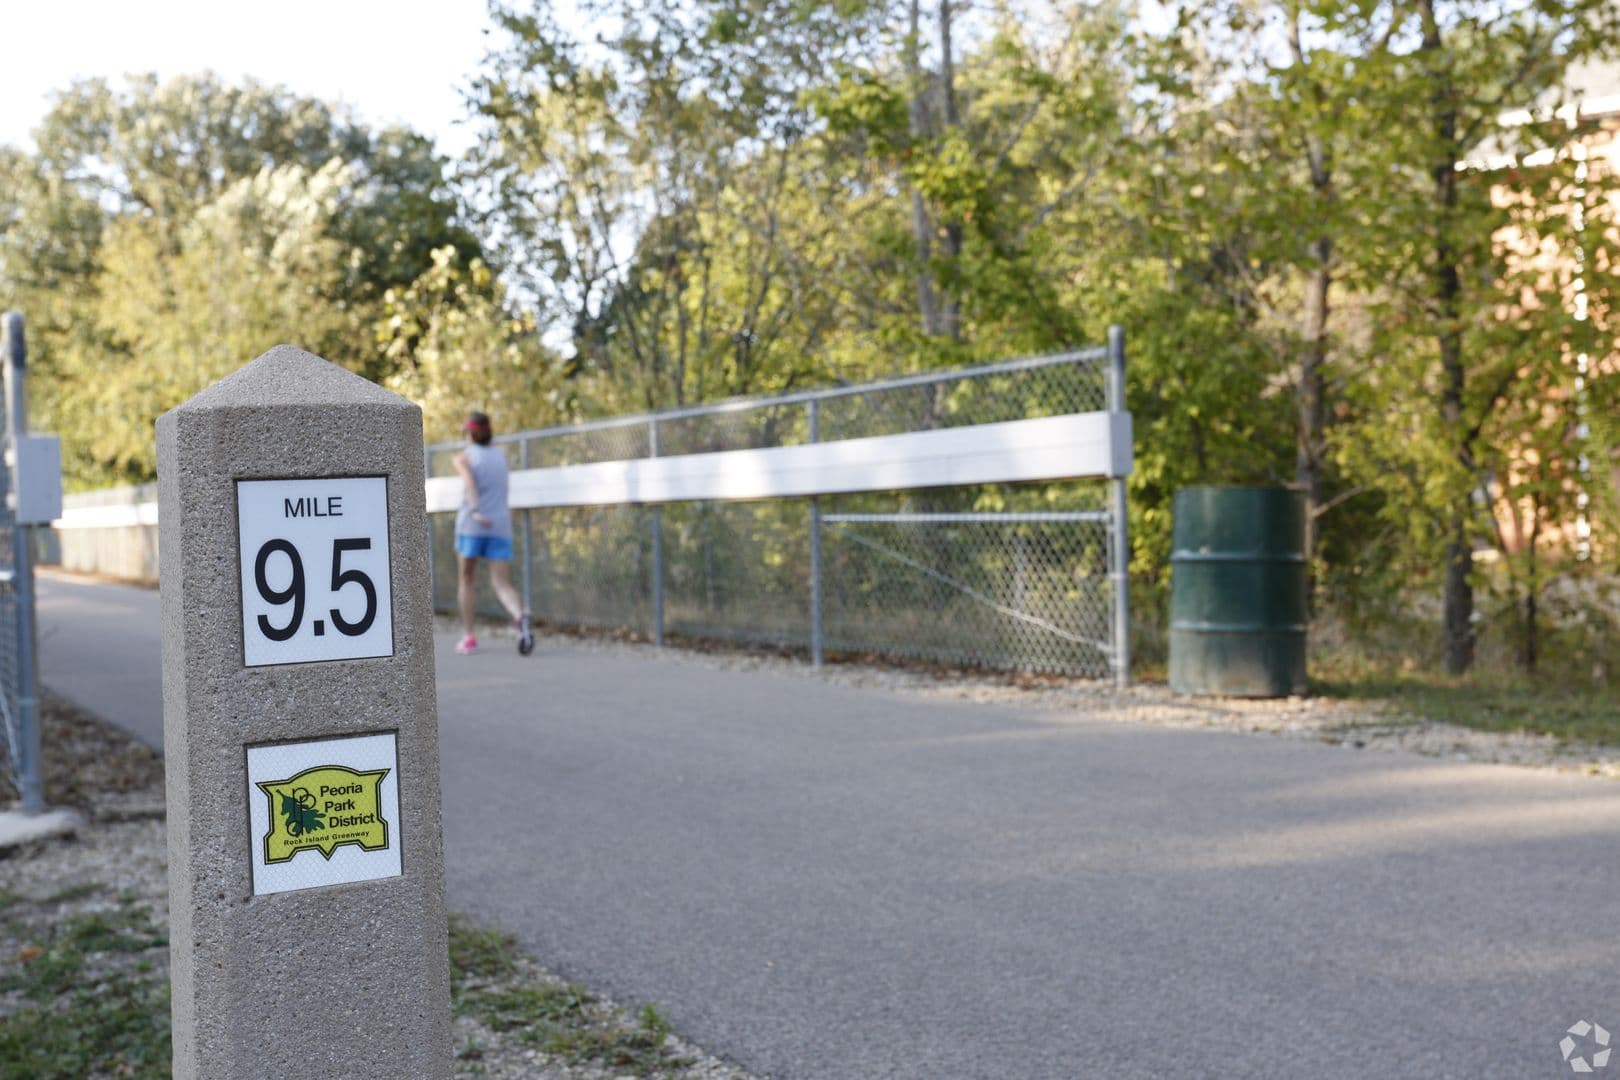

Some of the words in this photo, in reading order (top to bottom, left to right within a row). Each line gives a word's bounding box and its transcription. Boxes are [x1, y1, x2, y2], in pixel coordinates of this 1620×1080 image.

[284, 496, 343, 518] MILE
[254, 537, 377, 641] 9.5
[320, 782, 363, 797] Peoria
[324, 799, 355, 812] Park
[329, 812, 375, 828] District
[283, 838, 303, 846] Rock
[305, 835, 330, 843] Island
[332, 830, 370, 840] Greenway
